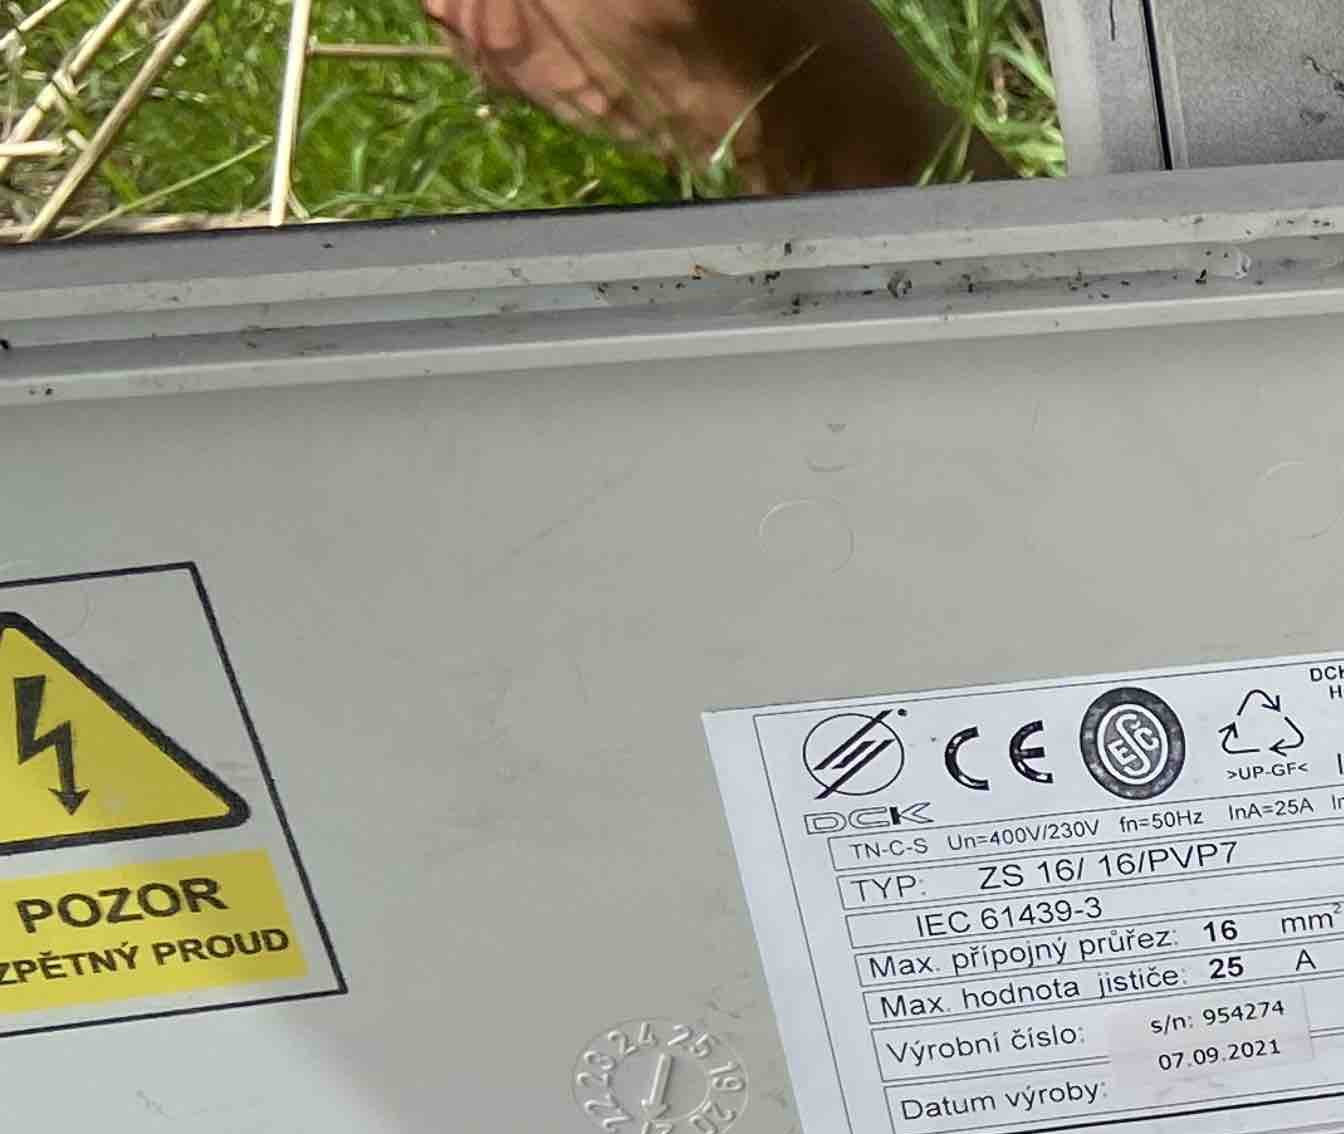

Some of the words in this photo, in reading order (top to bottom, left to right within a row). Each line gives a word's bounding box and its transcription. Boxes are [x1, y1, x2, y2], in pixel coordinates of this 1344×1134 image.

[804, 801, 936, 836] DCK
[851, 838, 930, 861] TN-C-S
[948, 818, 1100, 852] Un=400V/230V
[1119, 809, 1204, 833] fn=50Hz
[1228, 798, 1315, 822] InA=25A
[851, 874, 927, 903] TYP:
[978, 864, 1024, 891] ZS
[1037, 856, 1086, 884] 16/
[1098, 840, 1239, 877] 16/PVP7
[15, 876, 230, 934] POZOR
[916, 910, 971, 938] IEC
[980, 896, 1102, 932] 61439-3
[151, 928, 289, 966] PROUD
[869, 955, 941, 980] Max.
[952, 938, 1068, 977] přípojný
[1079, 928, 1179, 961] průřez:
[1203, 919, 1239, 943] 16
[880, 994, 952, 1019] Max.
[962, 978, 1081, 1010] hodnota
[1098, 965, 1188, 998] jističe:
[1209, 956, 1244, 980] 25
[1294, 948, 1318, 972] A
[887, 1033, 1000, 1067] Výrobní
[1011, 1023, 1085, 1051] číslo:
[1150, 1013, 1194, 1035] s/n:
[1202, 999, 1285, 1026] 954274
[1158, 1038, 1281, 1072] 07.09.2021
[900, 1092, 996, 1121] Datum
[1004, 1079, 1108, 1112] výroby:
